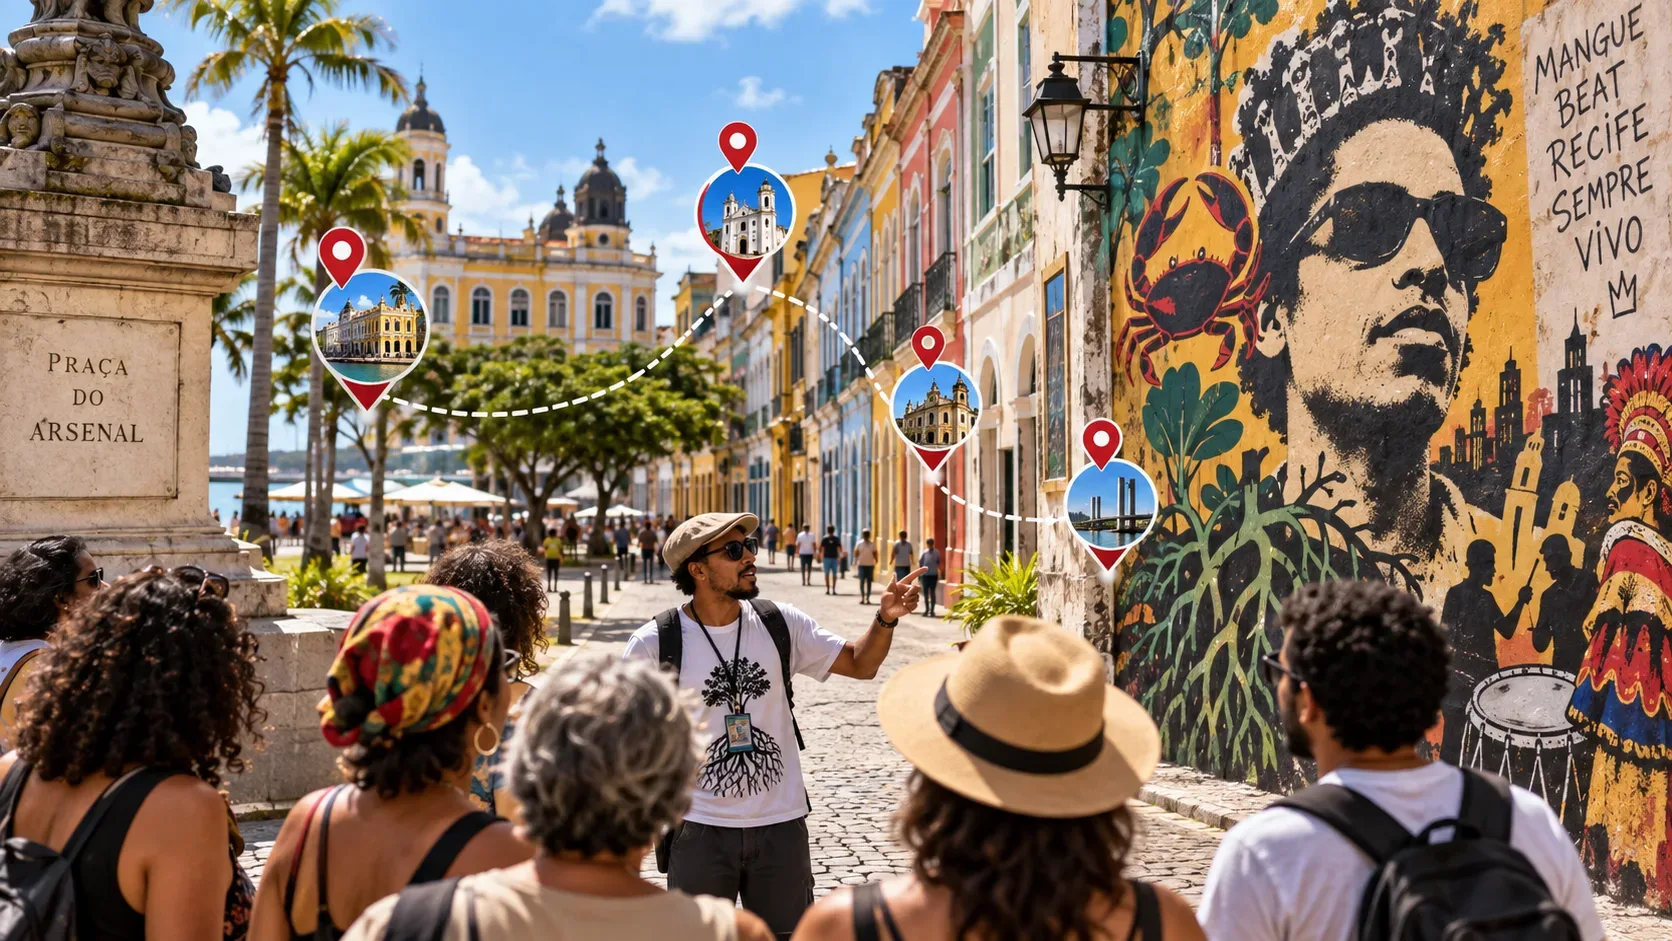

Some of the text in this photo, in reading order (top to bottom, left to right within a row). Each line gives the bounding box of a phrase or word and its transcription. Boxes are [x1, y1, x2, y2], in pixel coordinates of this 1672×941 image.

[1535, 3, 1644, 95] MANGUE
[1554, 60, 1625, 129] BEAT
[1552, 155, 1653, 233] SEMPRE
[47, 352, 128, 378] PRAÇA
[72, 388, 104, 406] DO
[29, 422, 144, 443] ARSENAL
